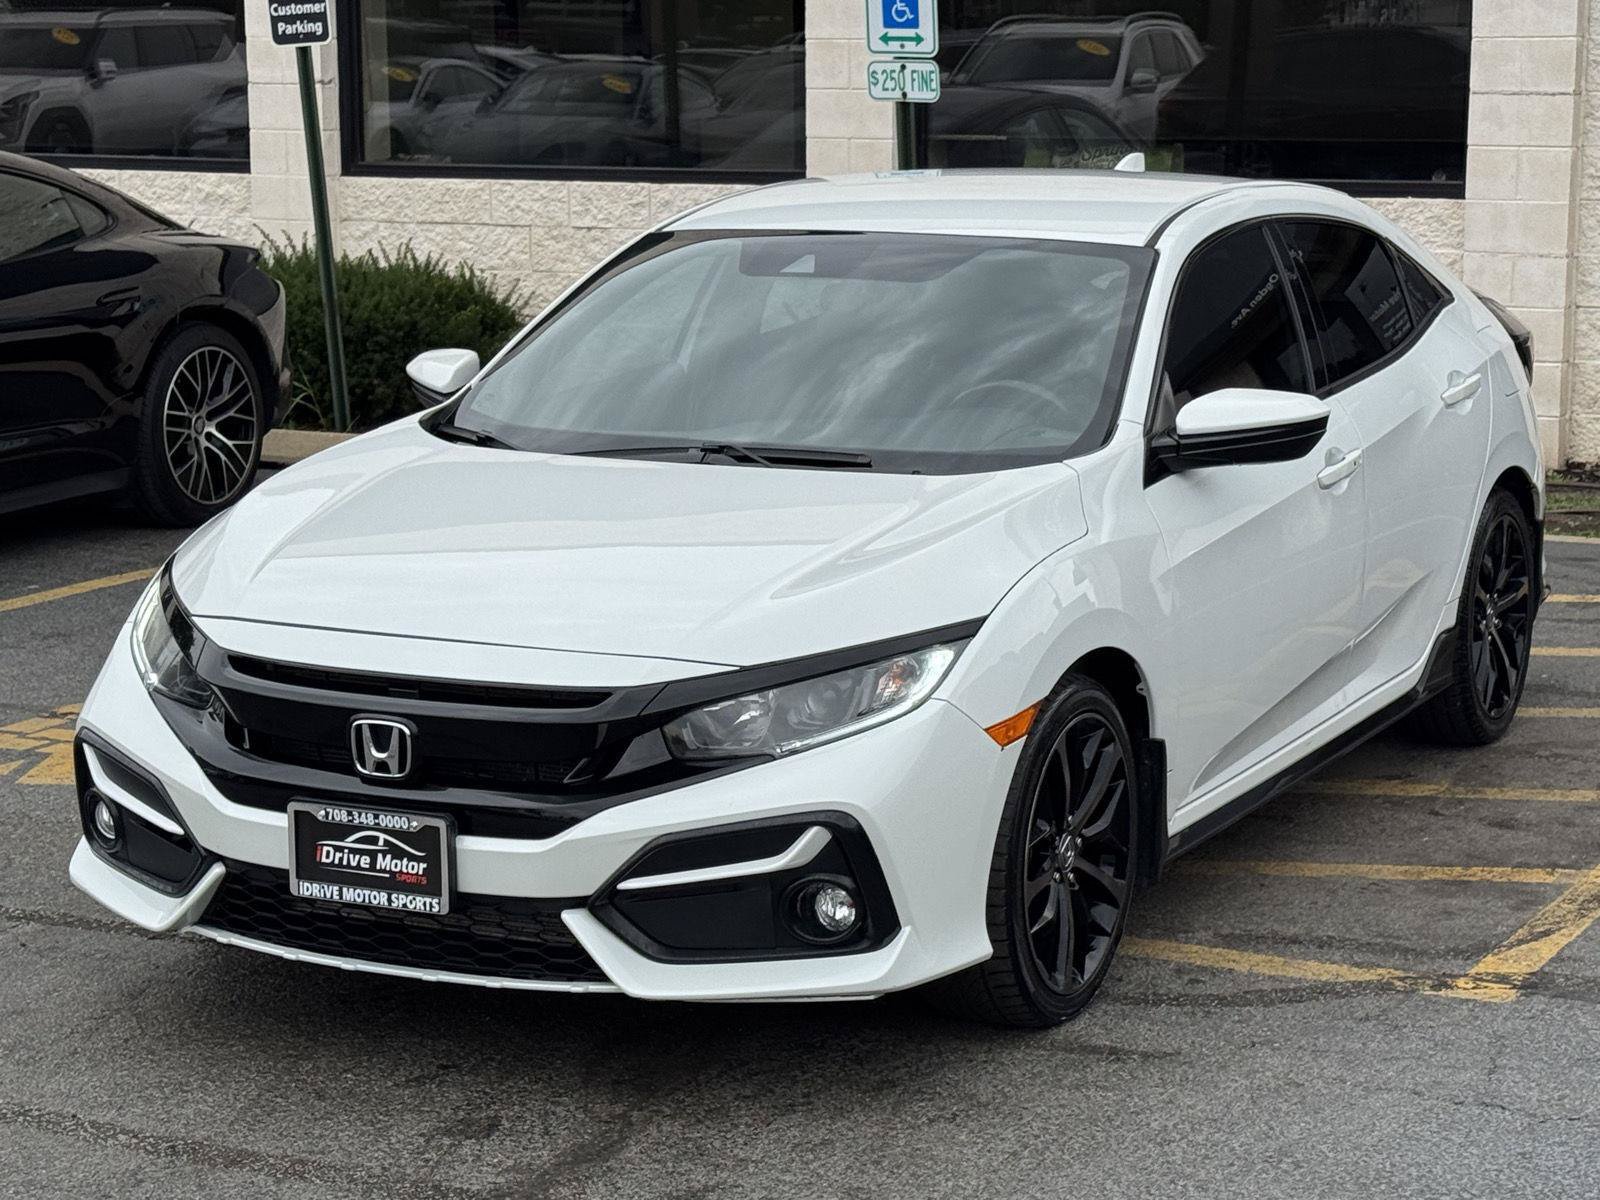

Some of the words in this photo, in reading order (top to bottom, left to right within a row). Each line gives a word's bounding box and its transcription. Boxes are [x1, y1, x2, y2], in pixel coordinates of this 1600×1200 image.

[270, 2, 326, 17] Customer
[277, 20, 323, 36] Parking
[870, 69, 906, 92] $250
[911, 69, 936, 92] FINE
[326, 808, 409, 829] 708-348-0000
[316, 845, 371, 869] iDrive
[376, 853, 427, 875] Motor
[395, 873, 427, 885] SPORTS
[343, 887, 388, 906] MOTOR
[391, 894, 440, 913] SPORTS
